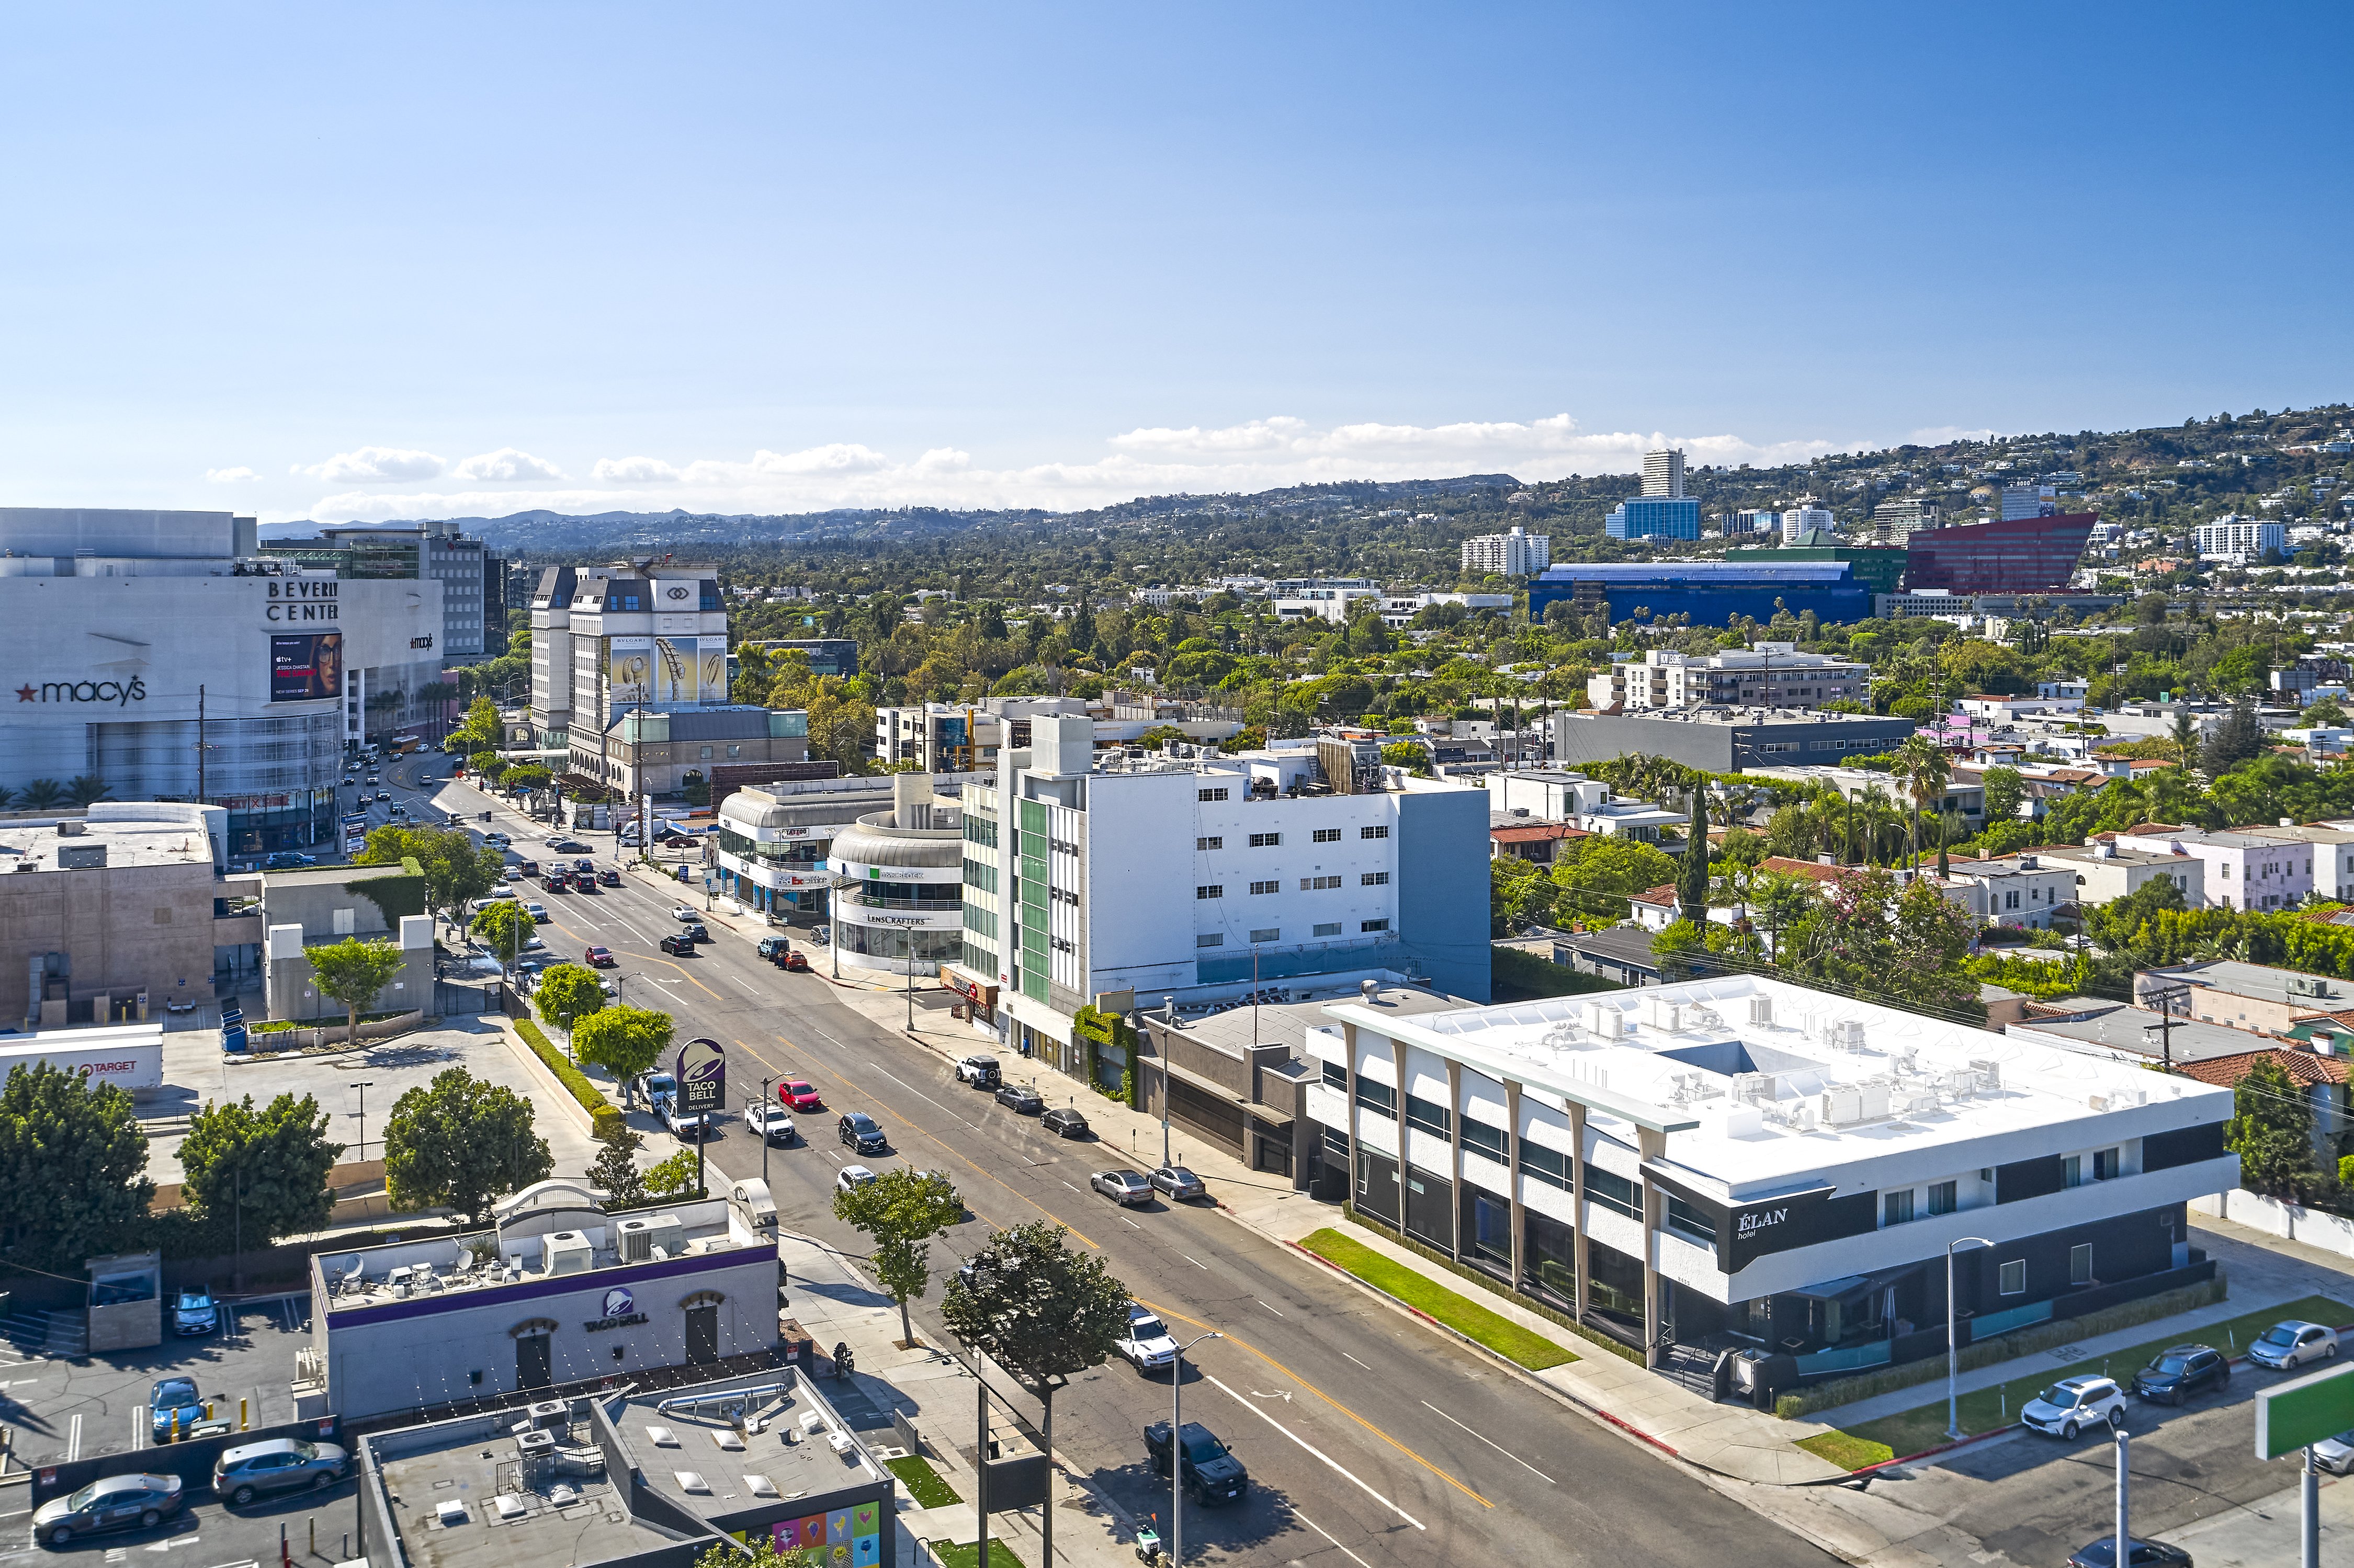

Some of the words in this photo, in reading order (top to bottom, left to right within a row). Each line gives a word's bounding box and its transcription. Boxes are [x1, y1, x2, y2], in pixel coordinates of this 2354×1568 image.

[268, 582, 338, 597] BEVERLY
[266, 605, 338, 621] CENTER
[414, 633, 433, 651] macy's
[42, 675, 145, 707] macy's
[778, 876, 804, 885] FedEx
[94, 1061, 137, 1072] TARGET
[686, 1081, 716, 1092] TACO
[689, 1090, 716, 1101] BELL
[1737, 1208, 1788, 1232] ÉLAN
[1738, 1230, 1756, 1240] hotel
[583, 1318, 618, 1333] TACO
